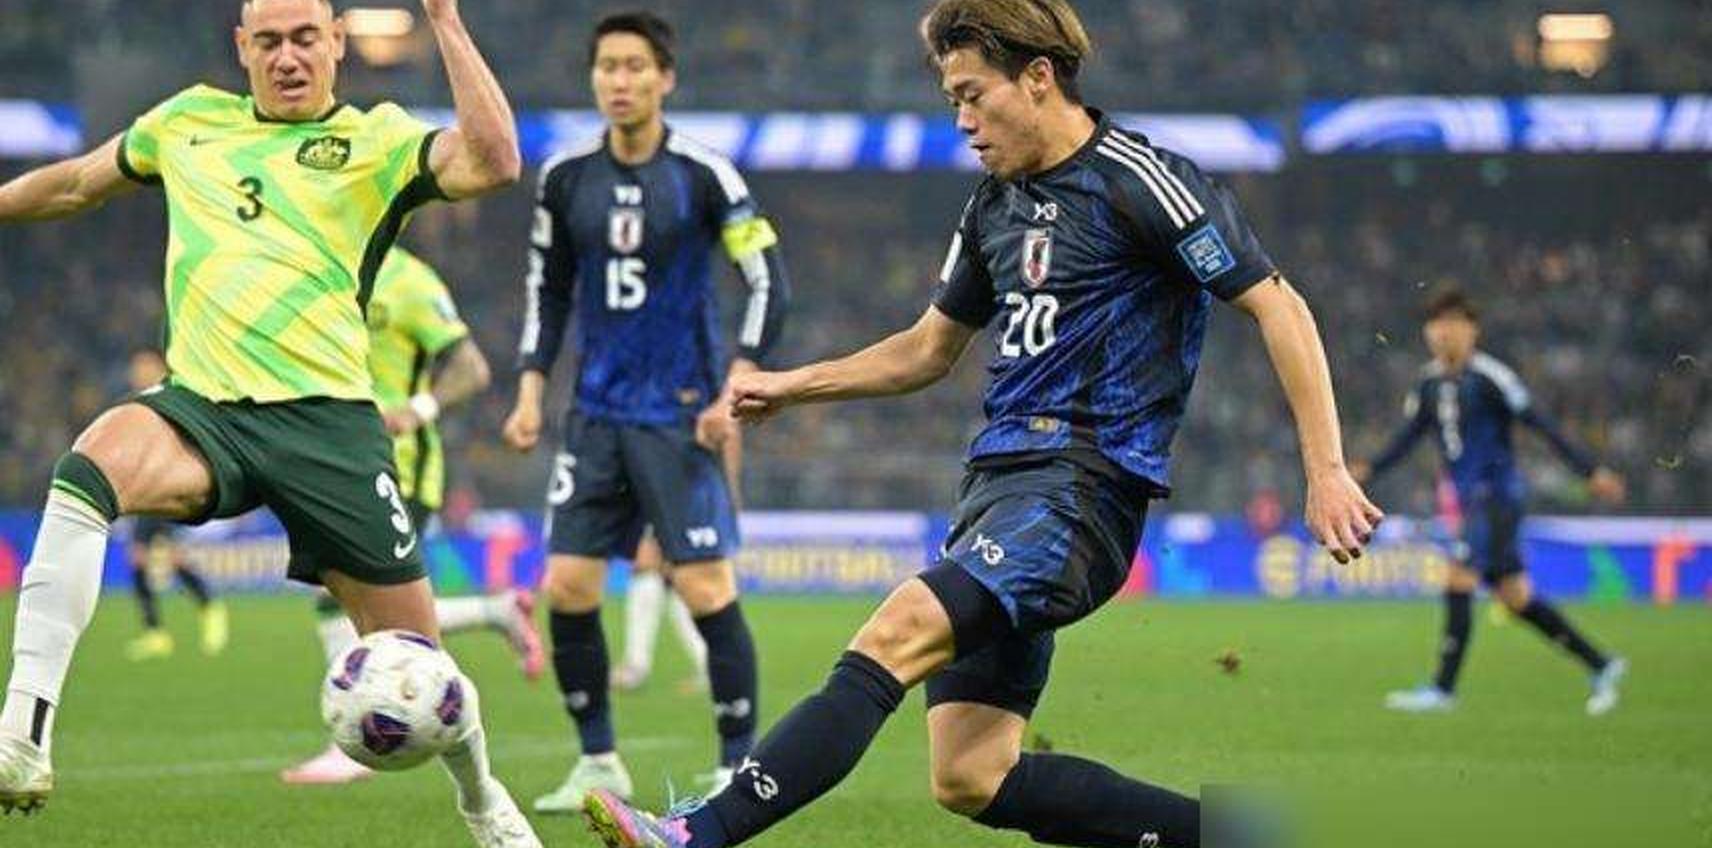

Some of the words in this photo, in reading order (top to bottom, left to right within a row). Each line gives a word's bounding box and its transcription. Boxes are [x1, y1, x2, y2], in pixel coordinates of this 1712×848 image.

[236, 176, 264, 223] 3
[607, 258, 647, 309] 15
[1001, 292, 1059, 357] 20
[375, 471, 409, 533] 3
